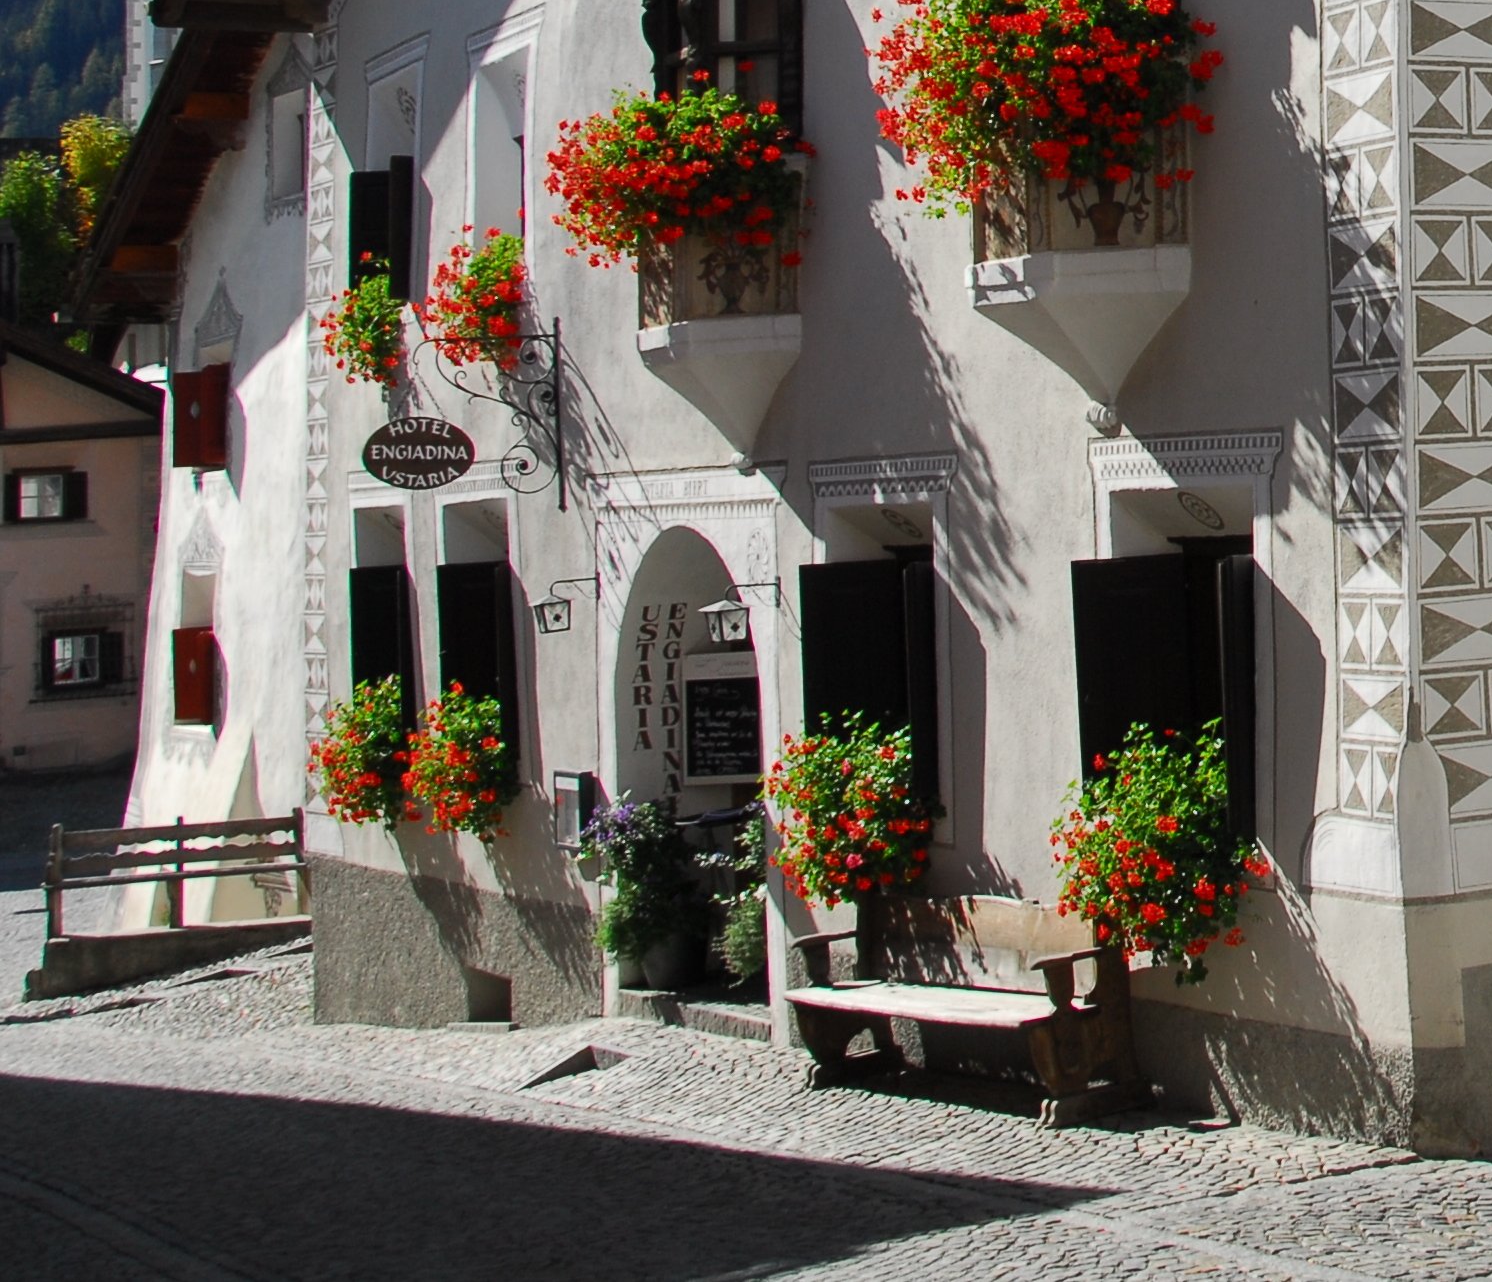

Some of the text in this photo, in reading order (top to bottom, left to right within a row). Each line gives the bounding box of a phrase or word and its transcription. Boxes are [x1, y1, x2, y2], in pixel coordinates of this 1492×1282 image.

[389, 418, 452, 439] HOTEL
[371, 444, 469, 461] ENGIADINA
[381, 465, 461, 488] USTARIA
[632, 604, 661, 752] USTARIA
